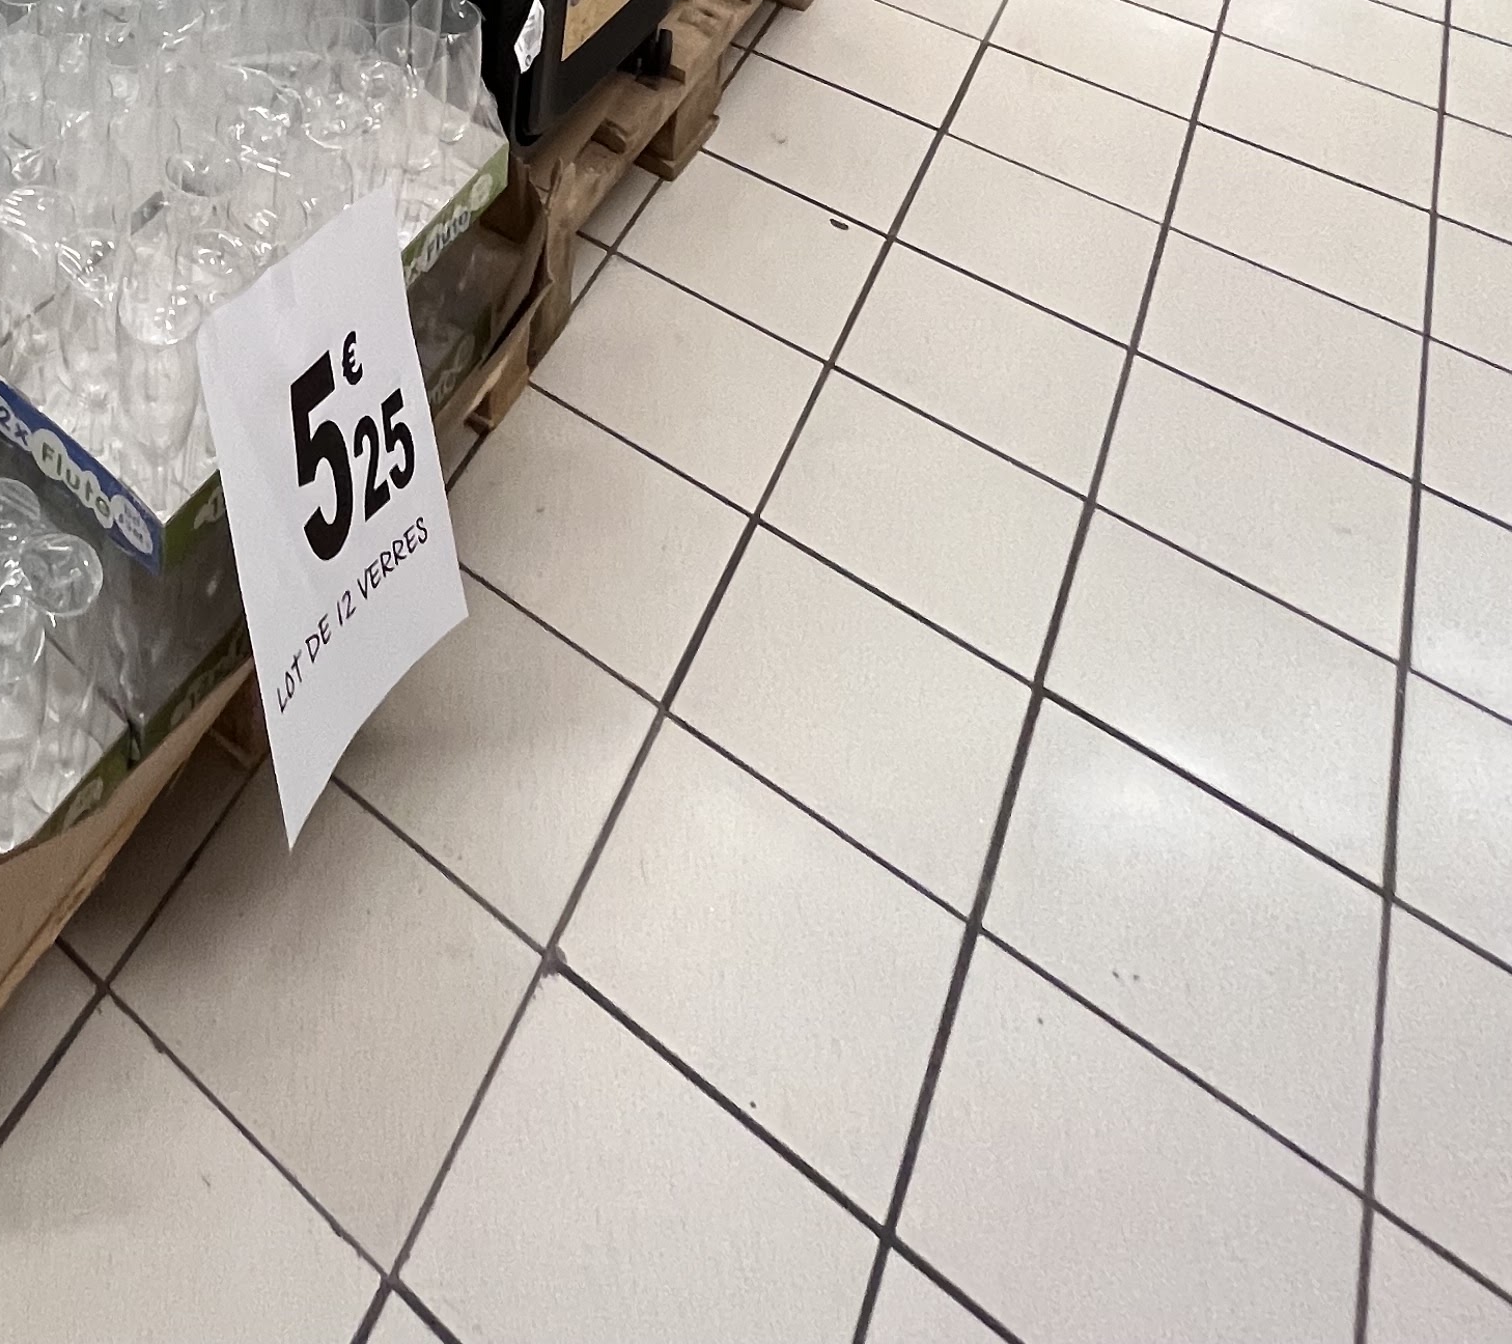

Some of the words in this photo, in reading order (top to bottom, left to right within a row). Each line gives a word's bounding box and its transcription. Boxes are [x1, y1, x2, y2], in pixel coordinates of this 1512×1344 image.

[276, 648, 303, 714] LOT
[304, 613, 332, 664] DE
[336, 589, 357, 627] 12
[357, 516, 429, 601] VERRES
